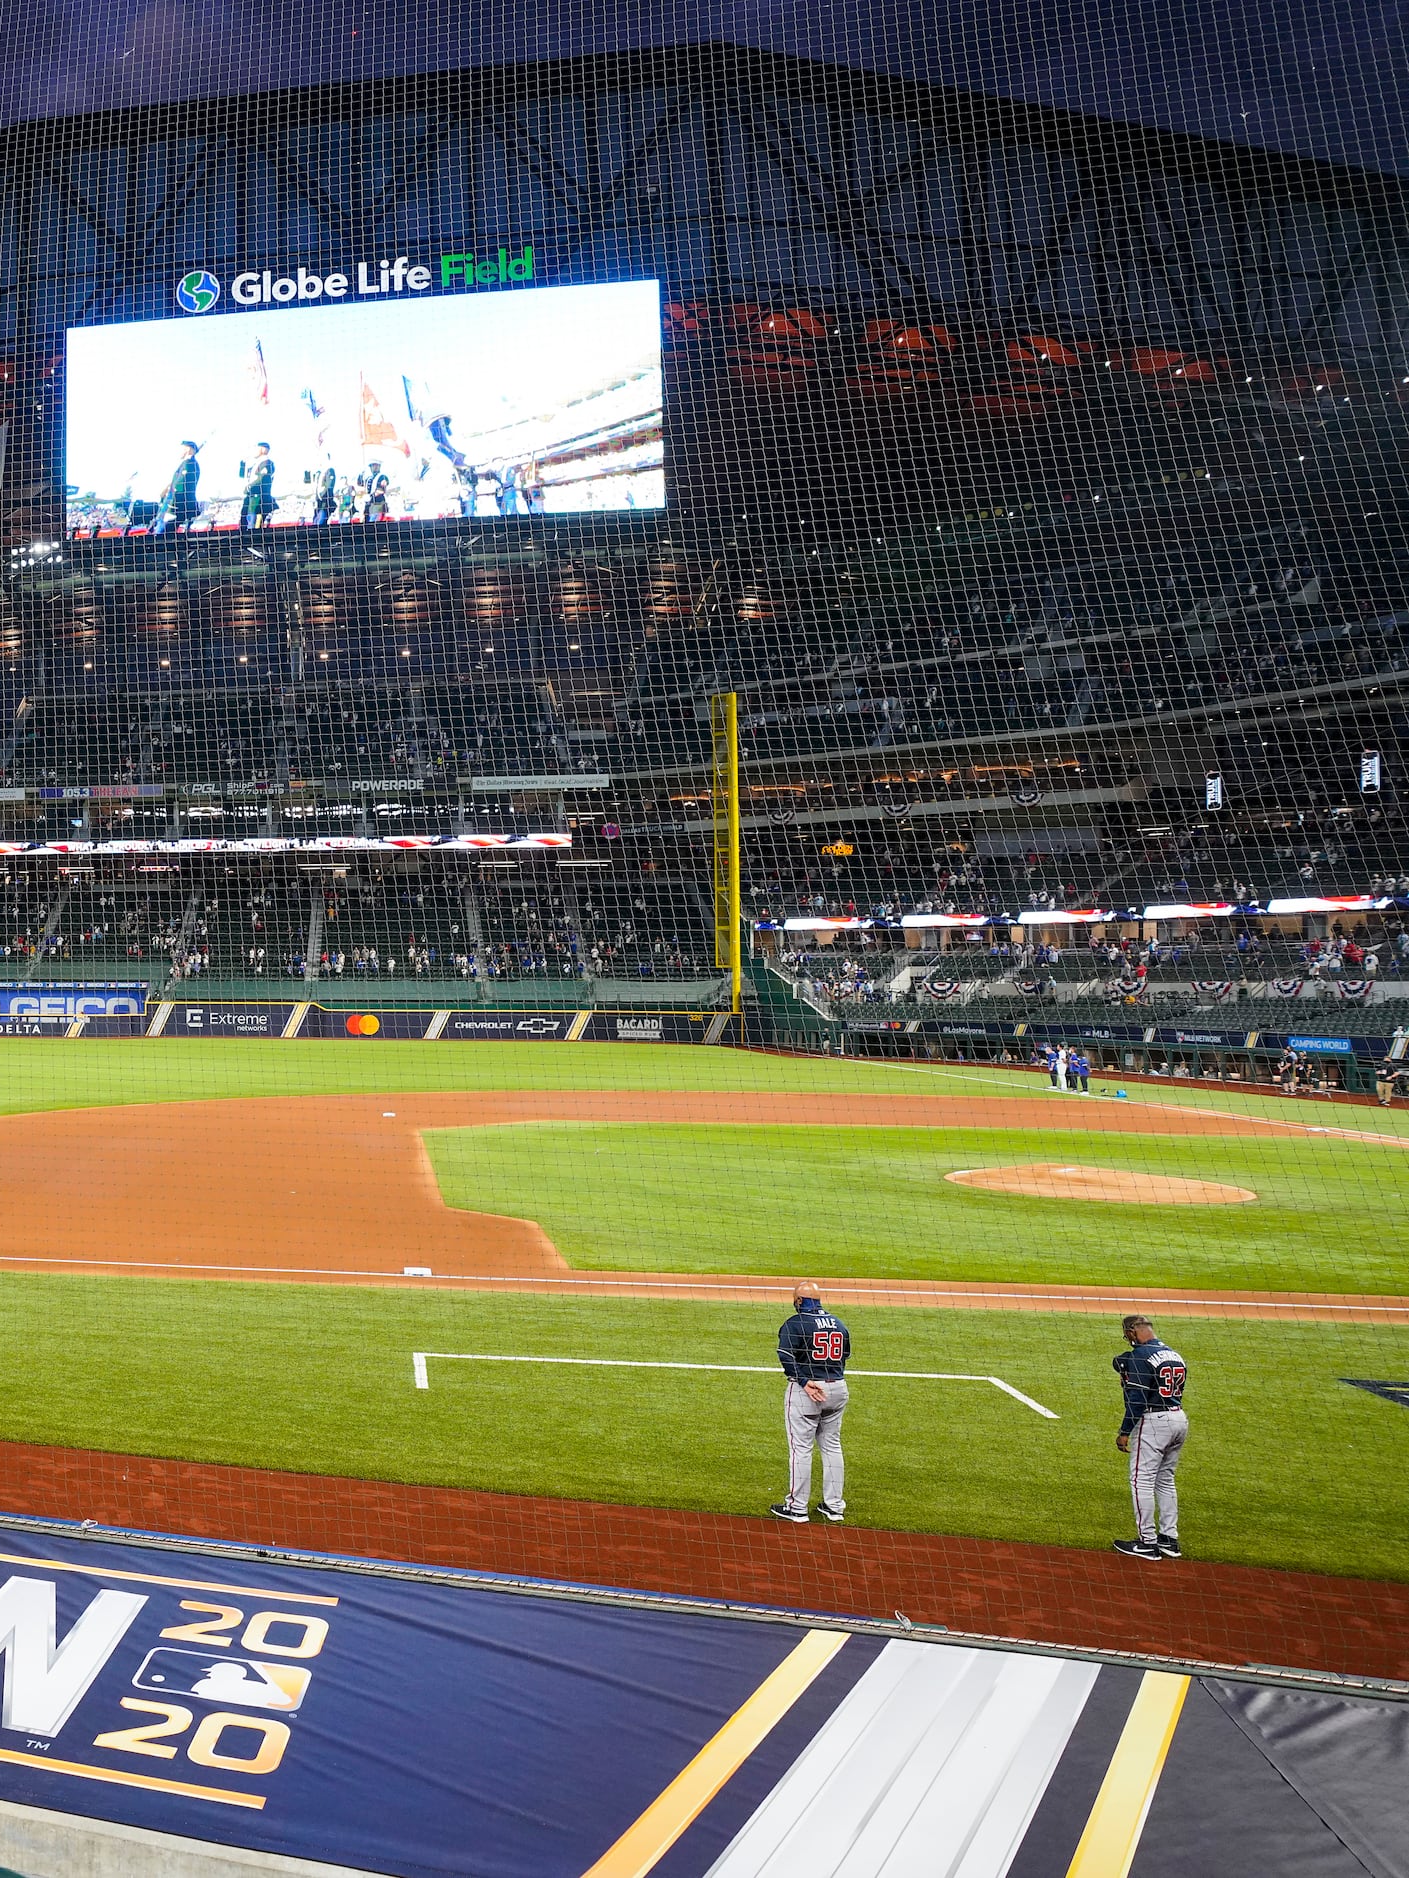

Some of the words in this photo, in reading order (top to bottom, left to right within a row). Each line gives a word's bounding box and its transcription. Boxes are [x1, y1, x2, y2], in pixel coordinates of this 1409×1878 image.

[231, 267, 349, 305] Globe
[357, 257, 431, 295] Life
[442, 246, 534, 287] Field
[1362, 757, 1372, 787] TRULY
[192, 783, 221, 794] PGL
[352, 779, 424, 791] POWERADE
[62, 787, 89, 798] 105.3
[93, 786, 113, 797] THE
[116, 786, 139, 796] FAN
[67, 841, 94, 852] WHAT
[113, 840, 154, 851] PROUDLY
[10, 996, 139, 1024] GEICO
[209, 1012, 268, 1024] Extreme
[617, 1017, 663, 1030] BACARDÍ
[689, 1014, 704, 1022] 326
[455, 1021, 513, 1029] CHEVROLET
[942, 1025, 986, 1035] @LasMayores
[1195, 1035, 1222, 1043] NETWORK
[1290, 1039, 1322, 1049] CAMPING
[1322, 1041, 1349, 1050] WORLD
[814, 1317, 838, 1330] HALE
[812, 1331, 844, 1361] 58
[1159, 1366, 1186, 1398] 37
[158, 1599, 330, 1659] 20
[93, 1696, 291, 1775] 20
[25, 1738, 53, 1751] TM
